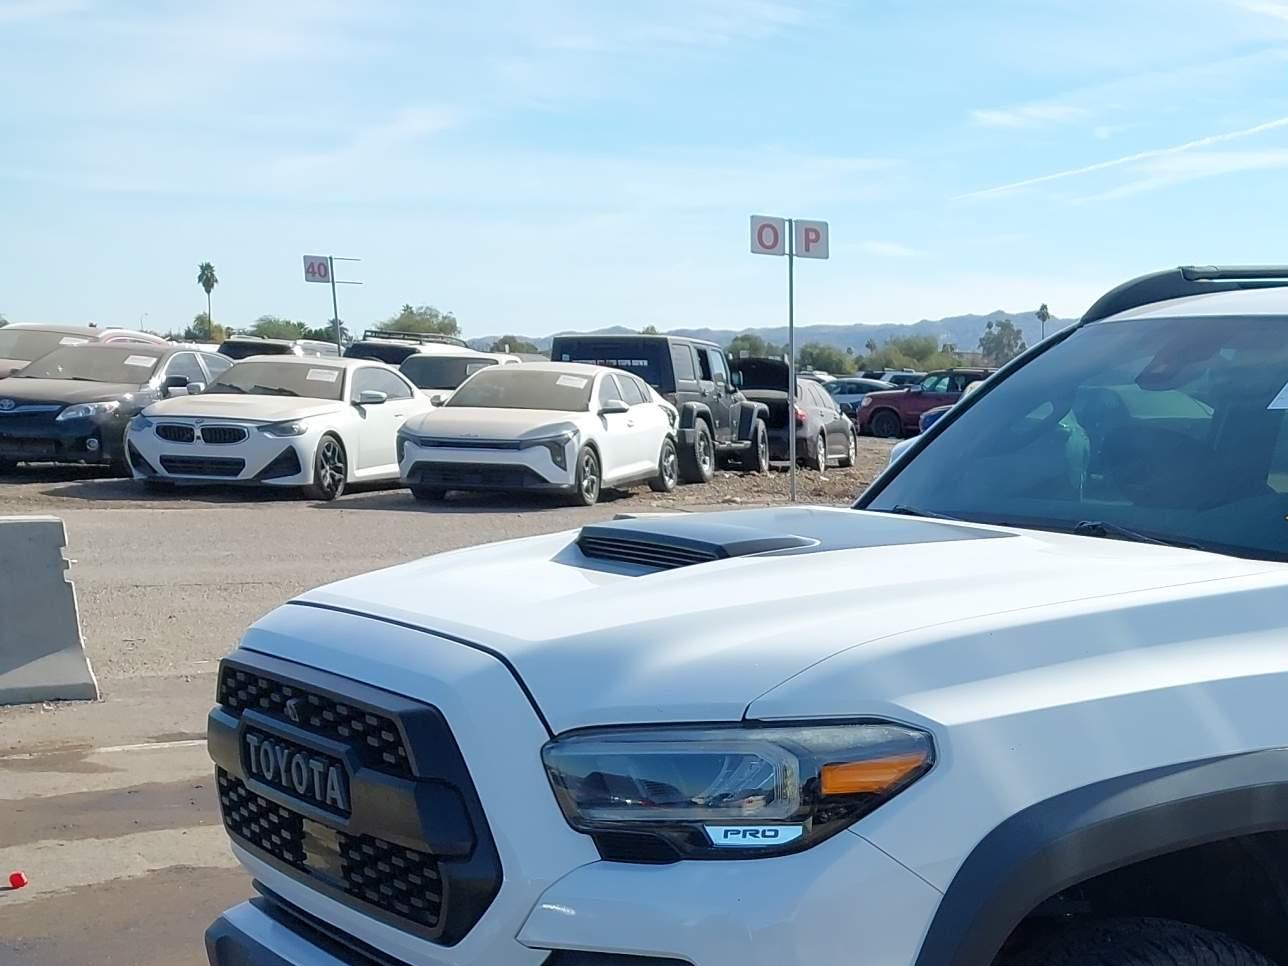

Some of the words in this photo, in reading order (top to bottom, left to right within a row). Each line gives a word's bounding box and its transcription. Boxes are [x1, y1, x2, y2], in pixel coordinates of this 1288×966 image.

[757, 223, 779, 250] O
[804, 227, 821, 252] P
[306, 262, 328, 278] 40
[246, 733, 345, 810] TOYOTA
[723, 829, 779, 839] PRO
